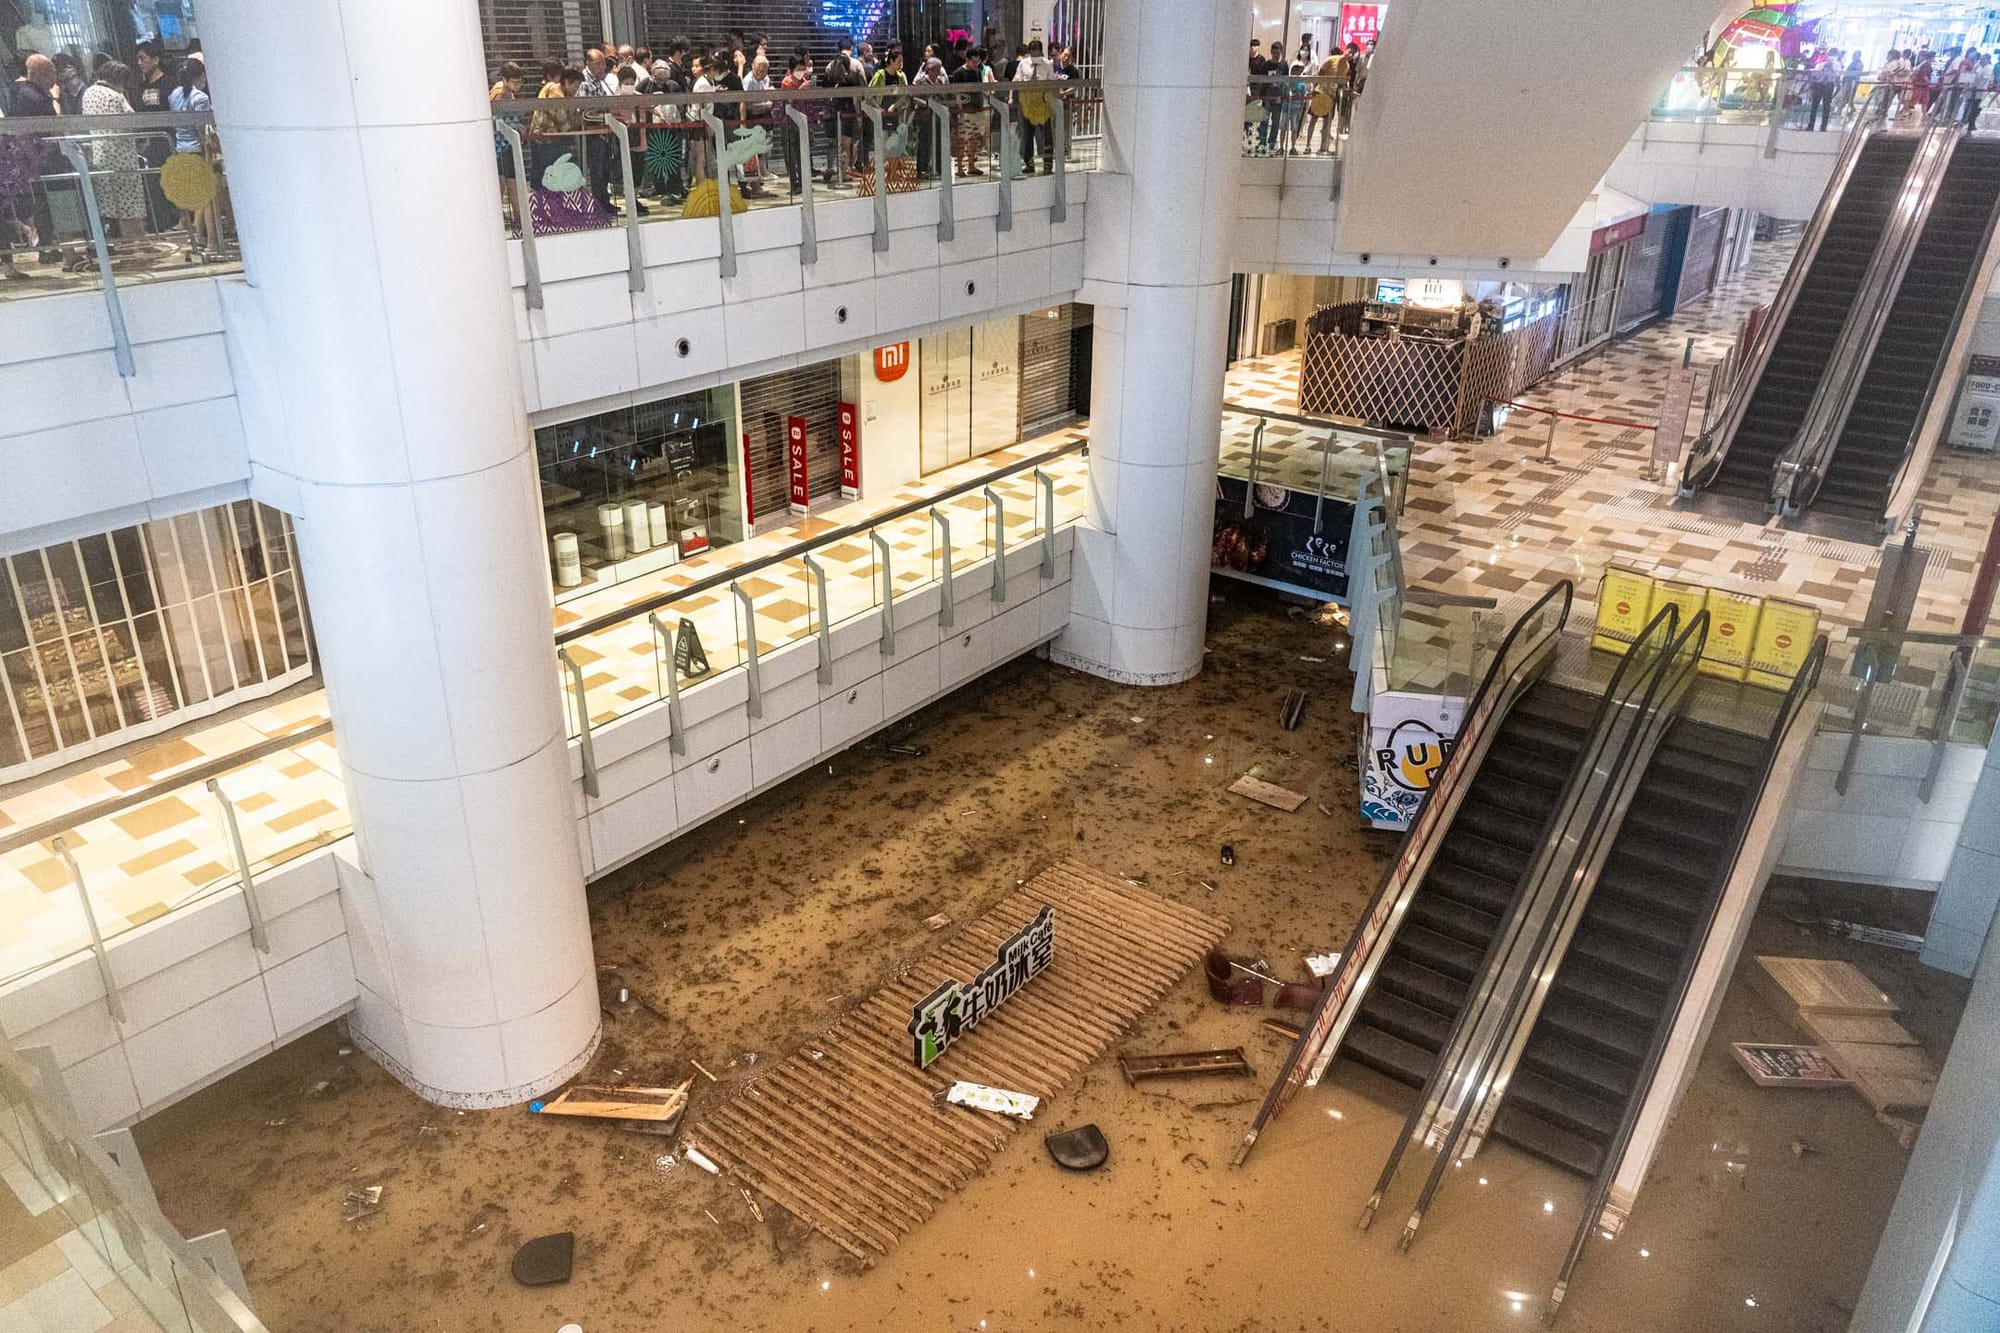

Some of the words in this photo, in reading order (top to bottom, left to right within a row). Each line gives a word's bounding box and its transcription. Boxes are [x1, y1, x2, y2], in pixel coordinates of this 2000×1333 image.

[792, 445, 804, 498] SALE
[842, 429, 854, 481] SALE
[1290, 551, 1319, 565] CHICKEN
[1320, 557, 1346, 570] FACTOR
[1008, 941, 1030, 964] Milk
[1029, 920, 1053, 946] Café
[959, 933, 1053, 1026] 牛奶冰室
